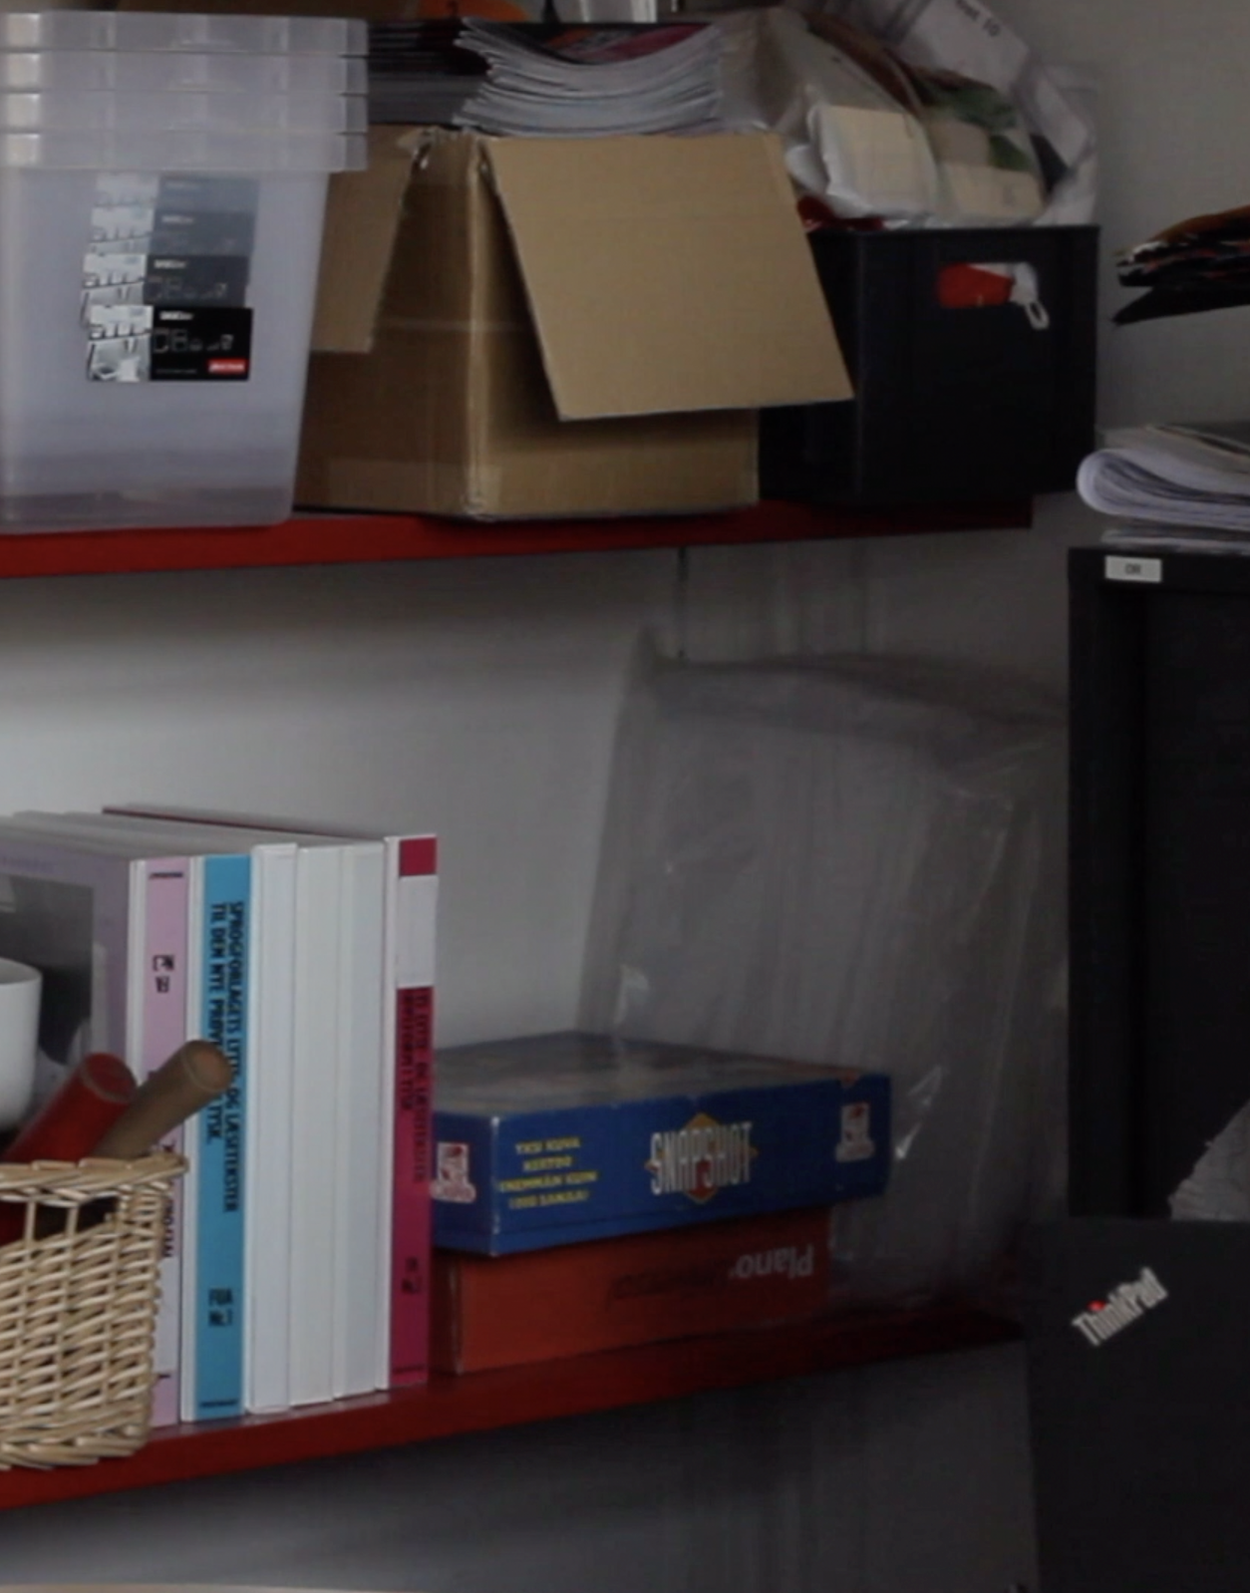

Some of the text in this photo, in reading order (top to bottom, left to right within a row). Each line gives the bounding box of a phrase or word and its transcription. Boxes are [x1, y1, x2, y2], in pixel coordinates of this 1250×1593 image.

[649, 1120, 753, 1196] SNAPSHOT
[734, 1245, 814, 1279] Plano
[1070, 1265, 1170, 1347] ThinkPad
